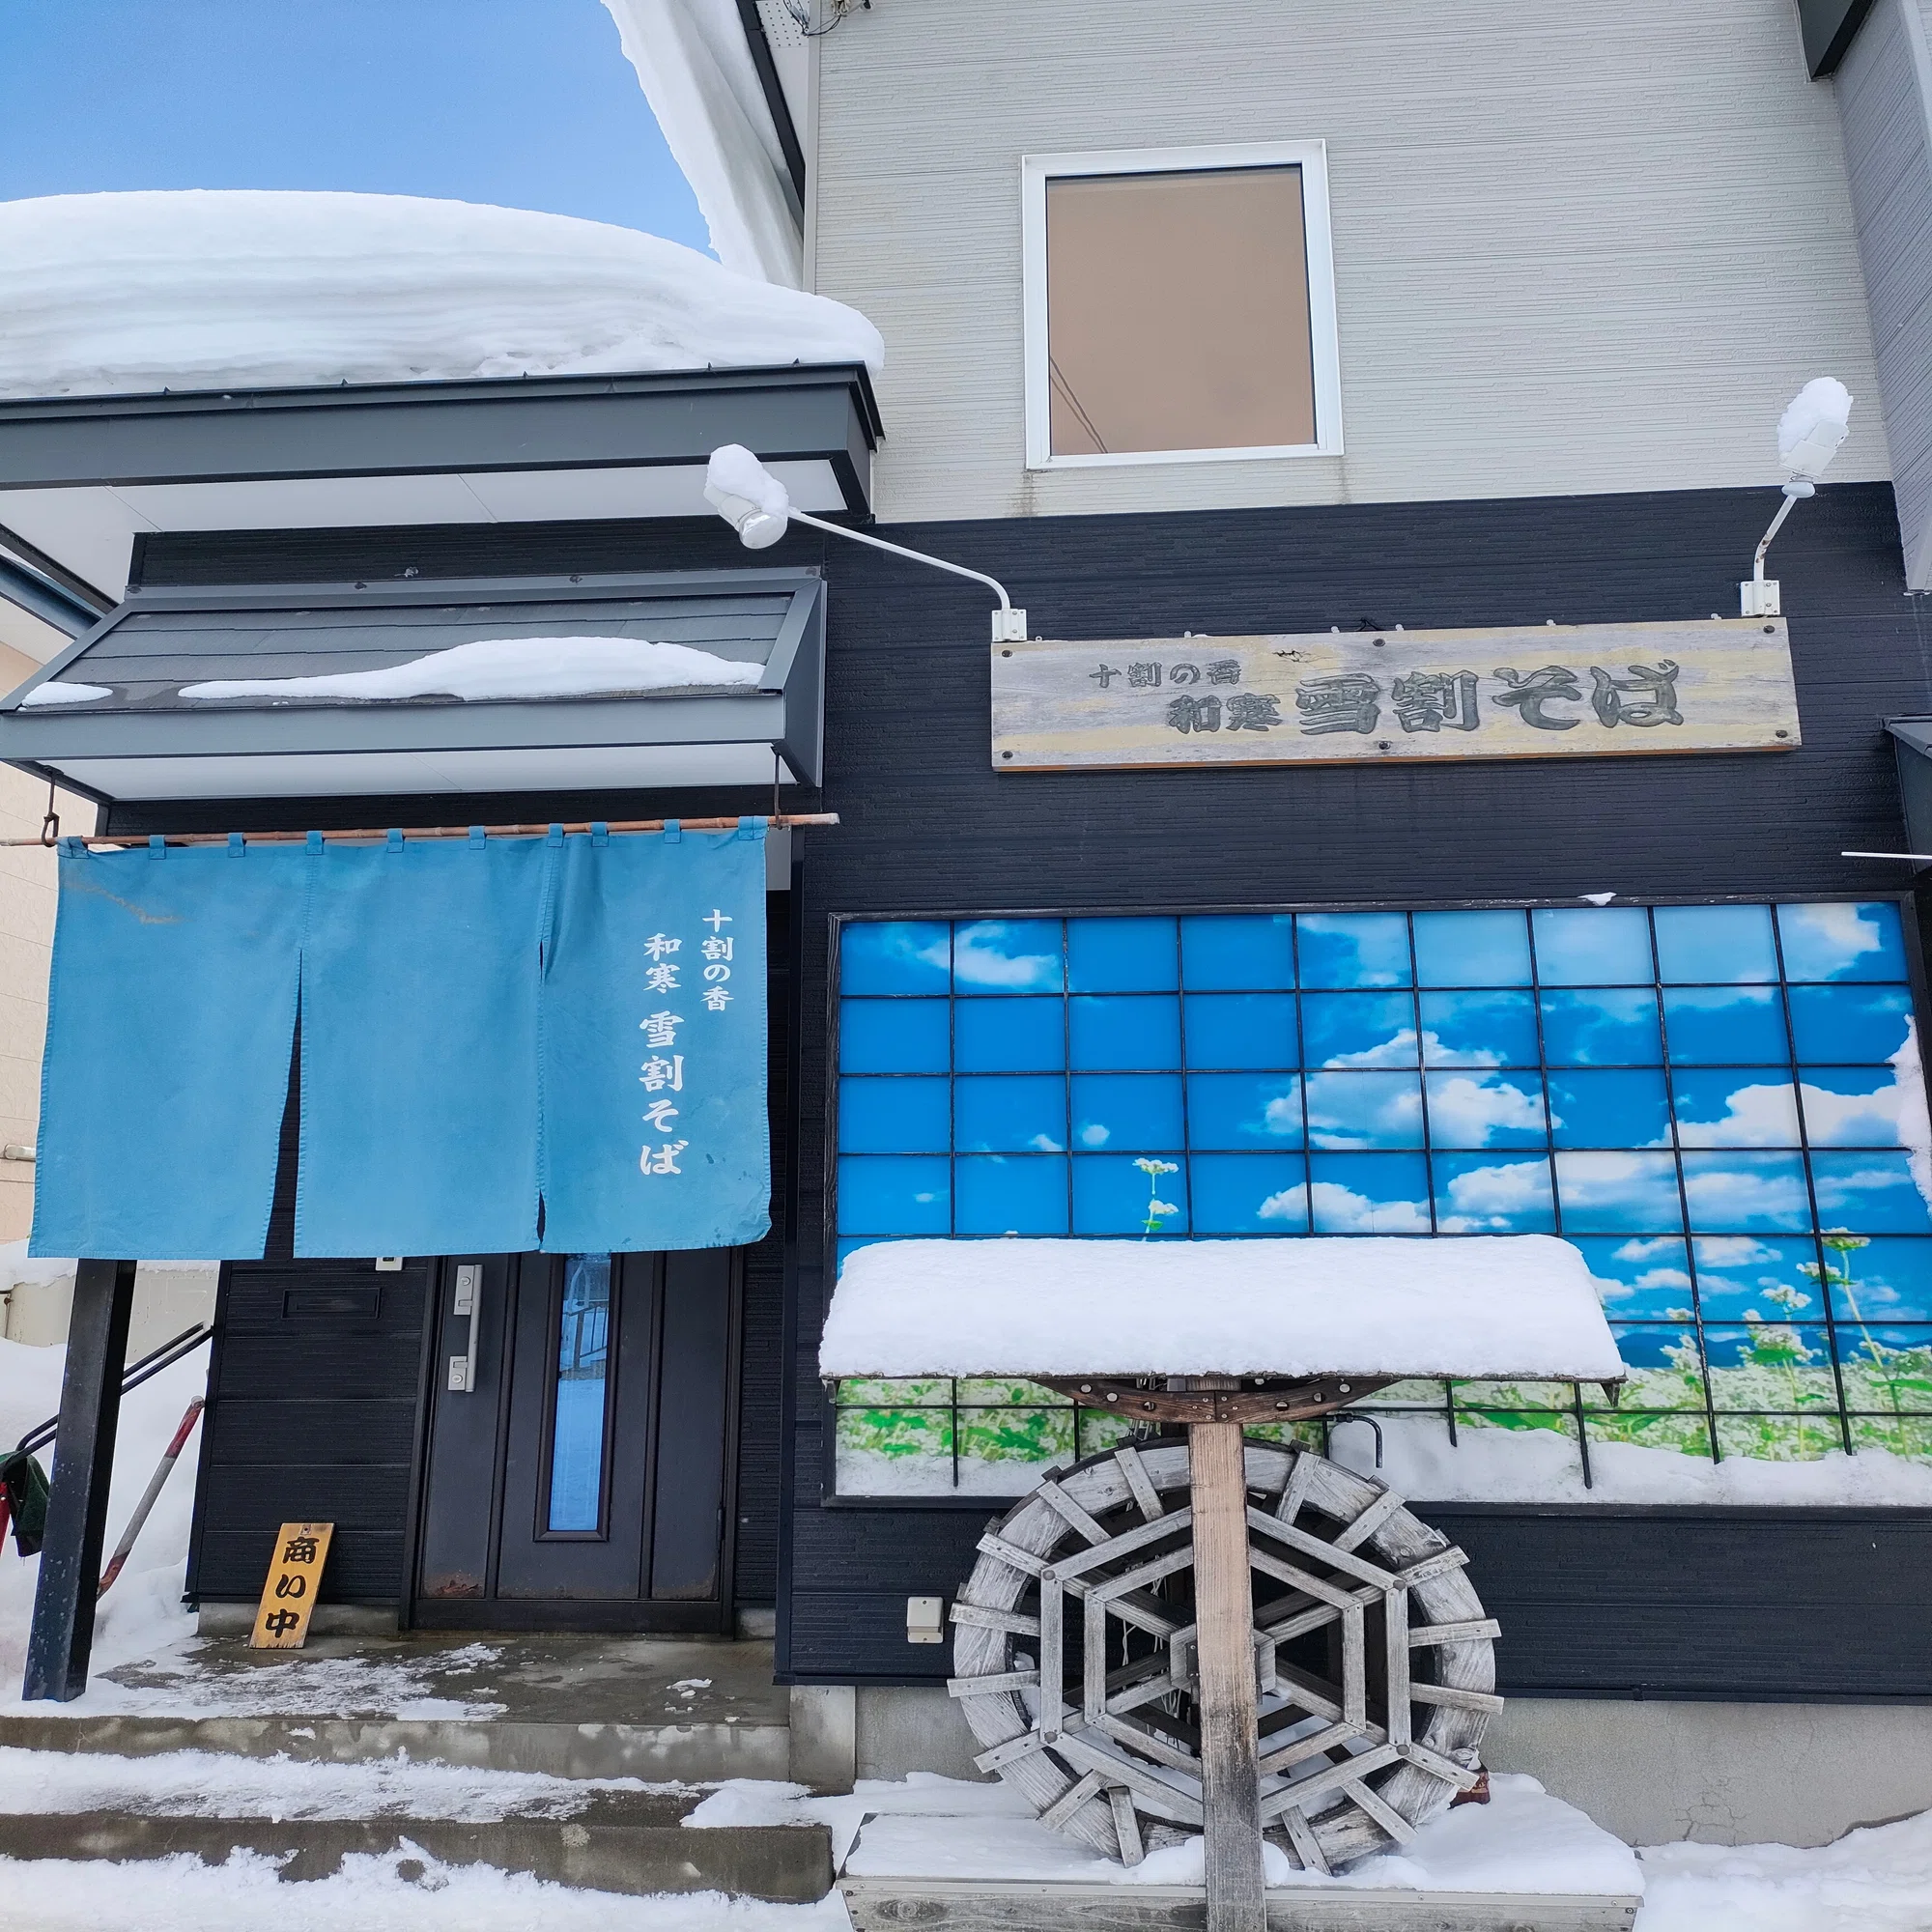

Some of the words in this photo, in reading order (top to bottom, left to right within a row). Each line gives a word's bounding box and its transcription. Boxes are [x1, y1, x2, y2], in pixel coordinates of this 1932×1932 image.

[1089, 659, 1242, 689] 十割の香
[1168, 692, 1283, 735] 和寒
[1294, 659, 1685, 736] 雪割そば
[642, 932, 683, 994] 和寒
[700, 908, 735, 1011] 十割の香
[639, 1010, 690, 1176] 雪割そば
[265, 1536, 320, 1638] 商い中
